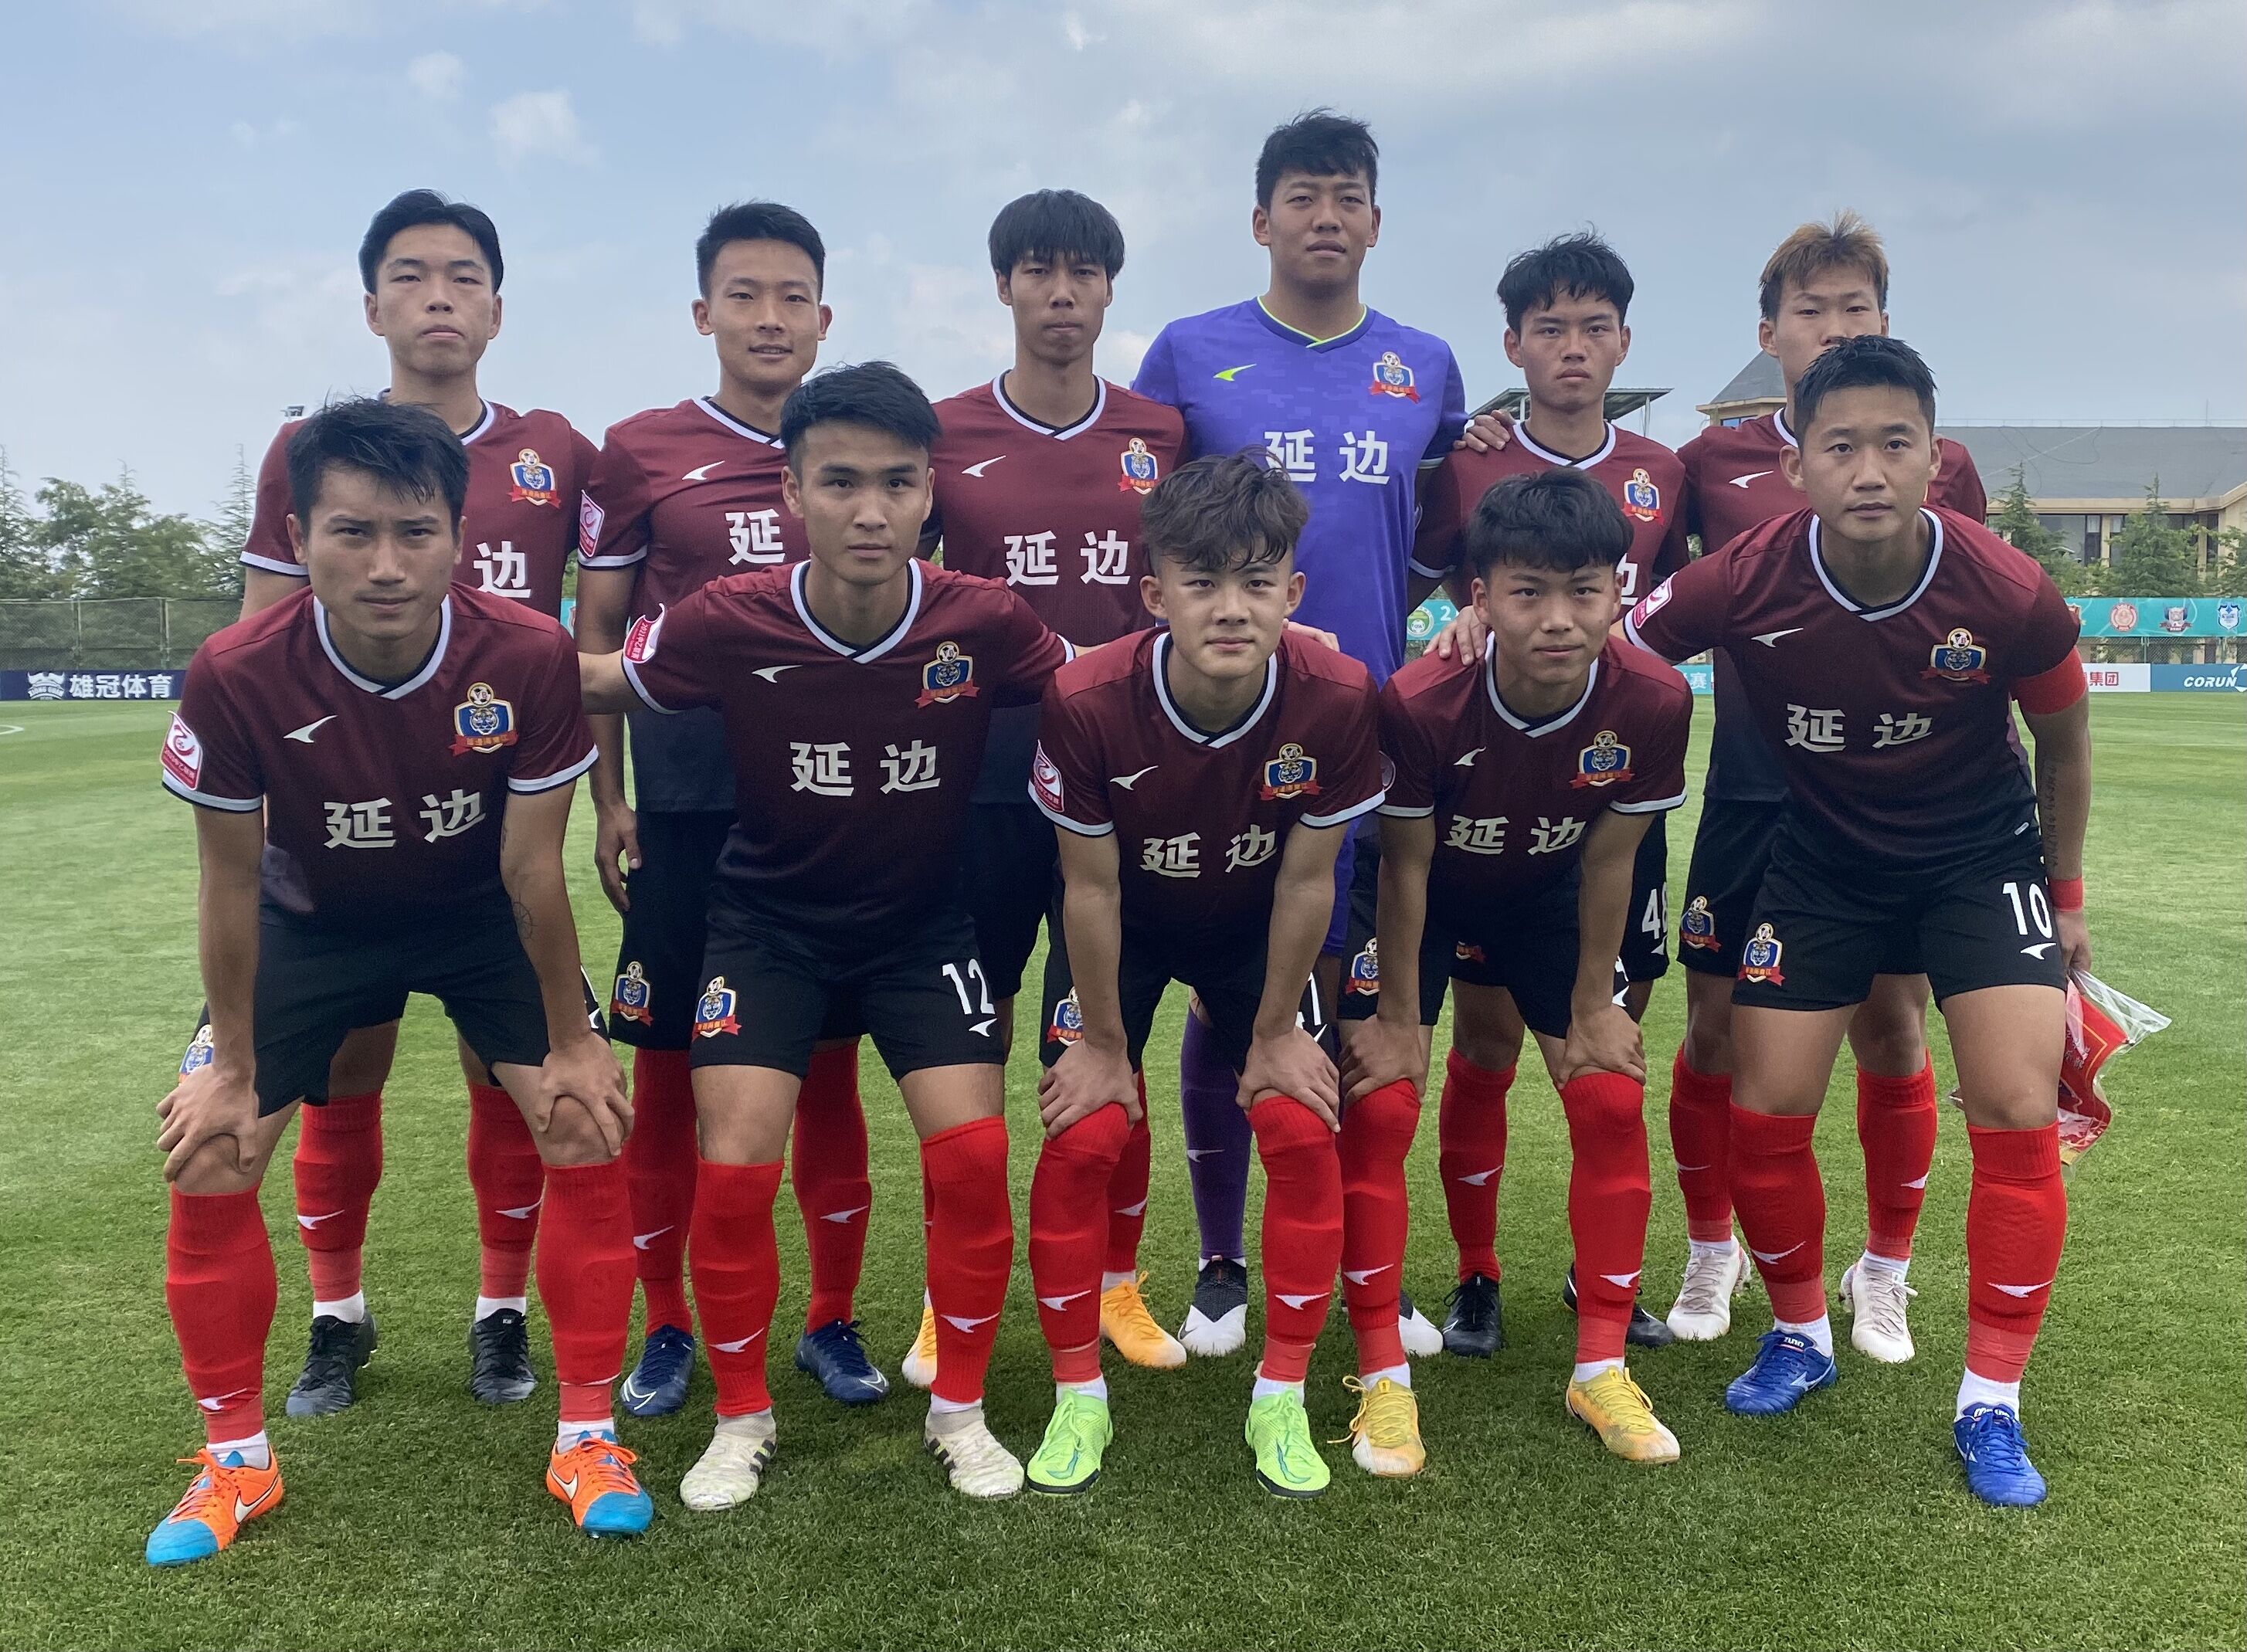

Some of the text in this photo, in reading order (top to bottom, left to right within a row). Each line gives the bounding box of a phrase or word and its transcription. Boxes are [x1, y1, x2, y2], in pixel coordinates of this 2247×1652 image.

[1264, 429, 1390, 484] 延边
[725, 509, 783, 565] 延
[1004, 530, 1130, 586] 延边
[473, 541, 531, 598] 边
[69, 673, 172, 698] 雄冠体育
[2184, 677, 2237, 687] CORUN
[1785, 704, 1933, 752] 延边
[789, 740, 941, 796] 延边
[323, 789, 486, 848] 延边
[1444, 816, 1587, 855] 延边
[1140, 824, 1277, 877] 延边
[2003, 882, 2052, 939] 10
[942, 959, 995, 1015] 12
